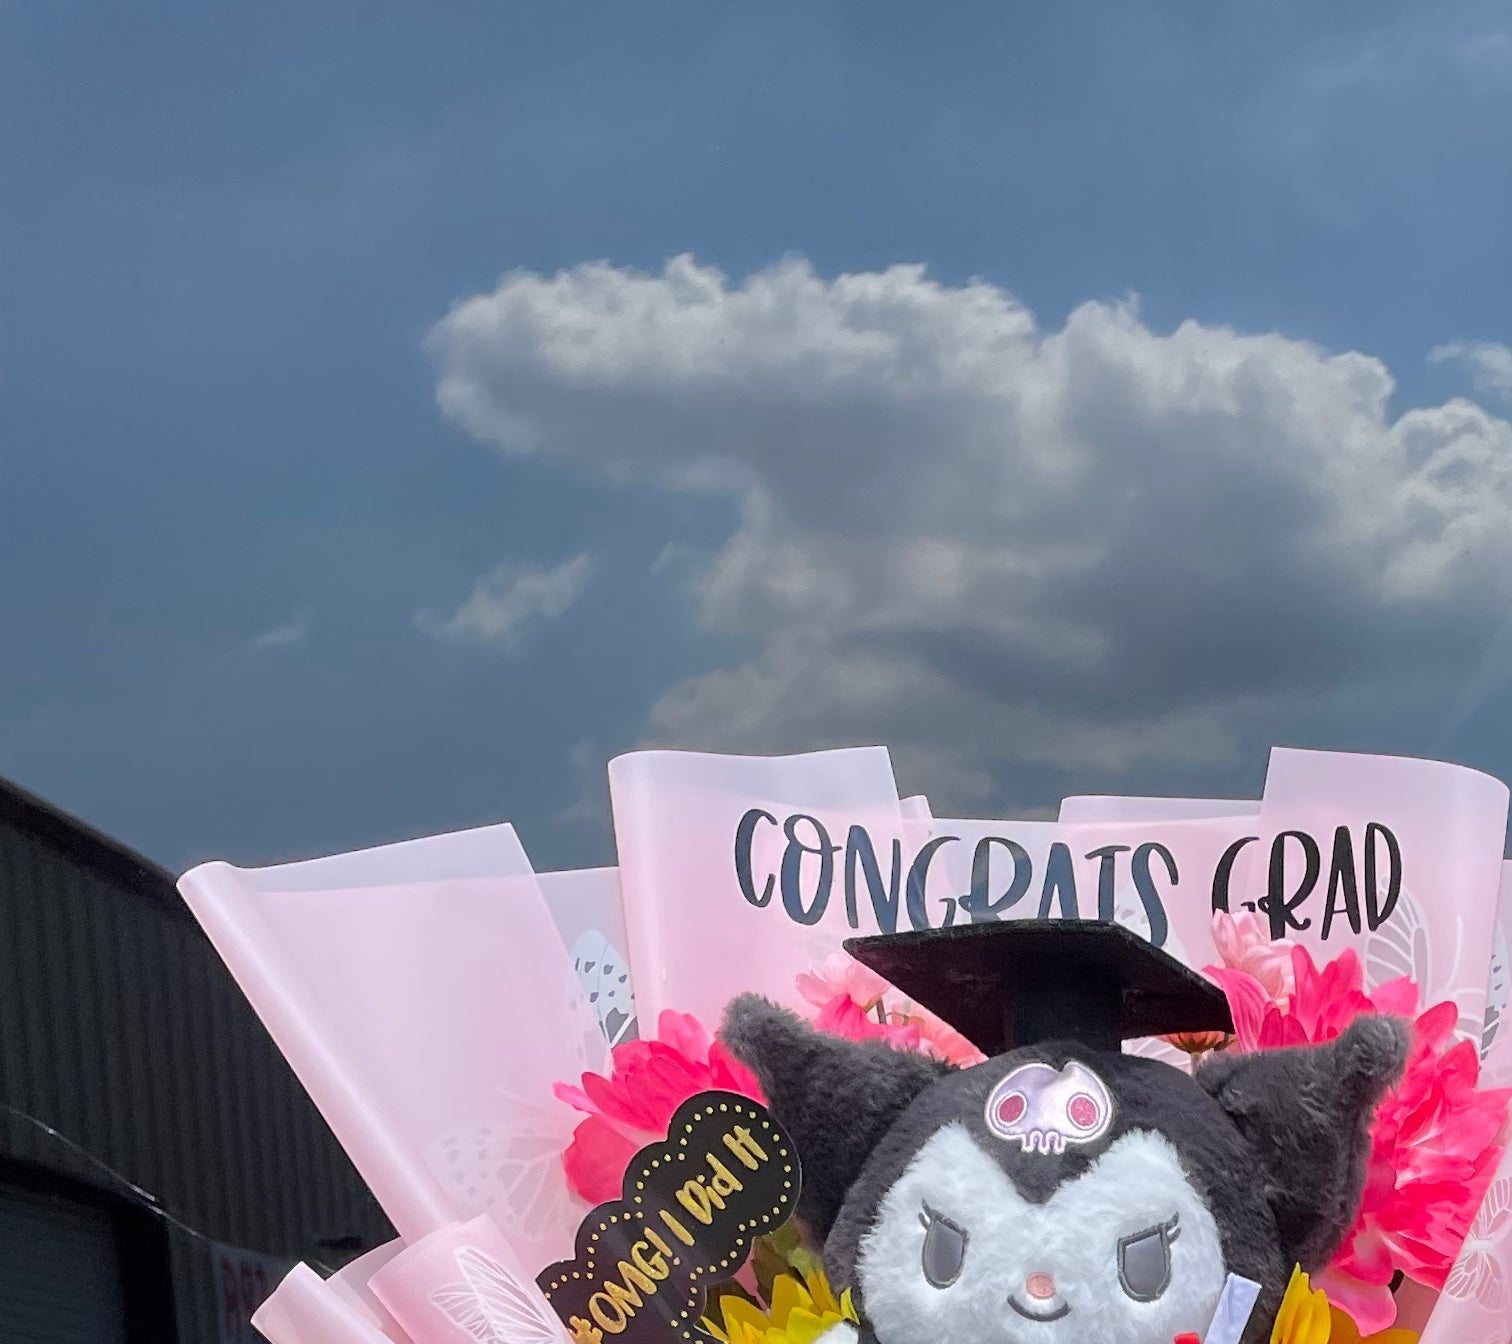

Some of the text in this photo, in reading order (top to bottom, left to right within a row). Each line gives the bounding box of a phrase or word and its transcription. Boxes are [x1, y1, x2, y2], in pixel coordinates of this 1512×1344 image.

[735, 808, 1402, 947] CONGRATS GRAD
[675, 1152, 743, 1225] Did
